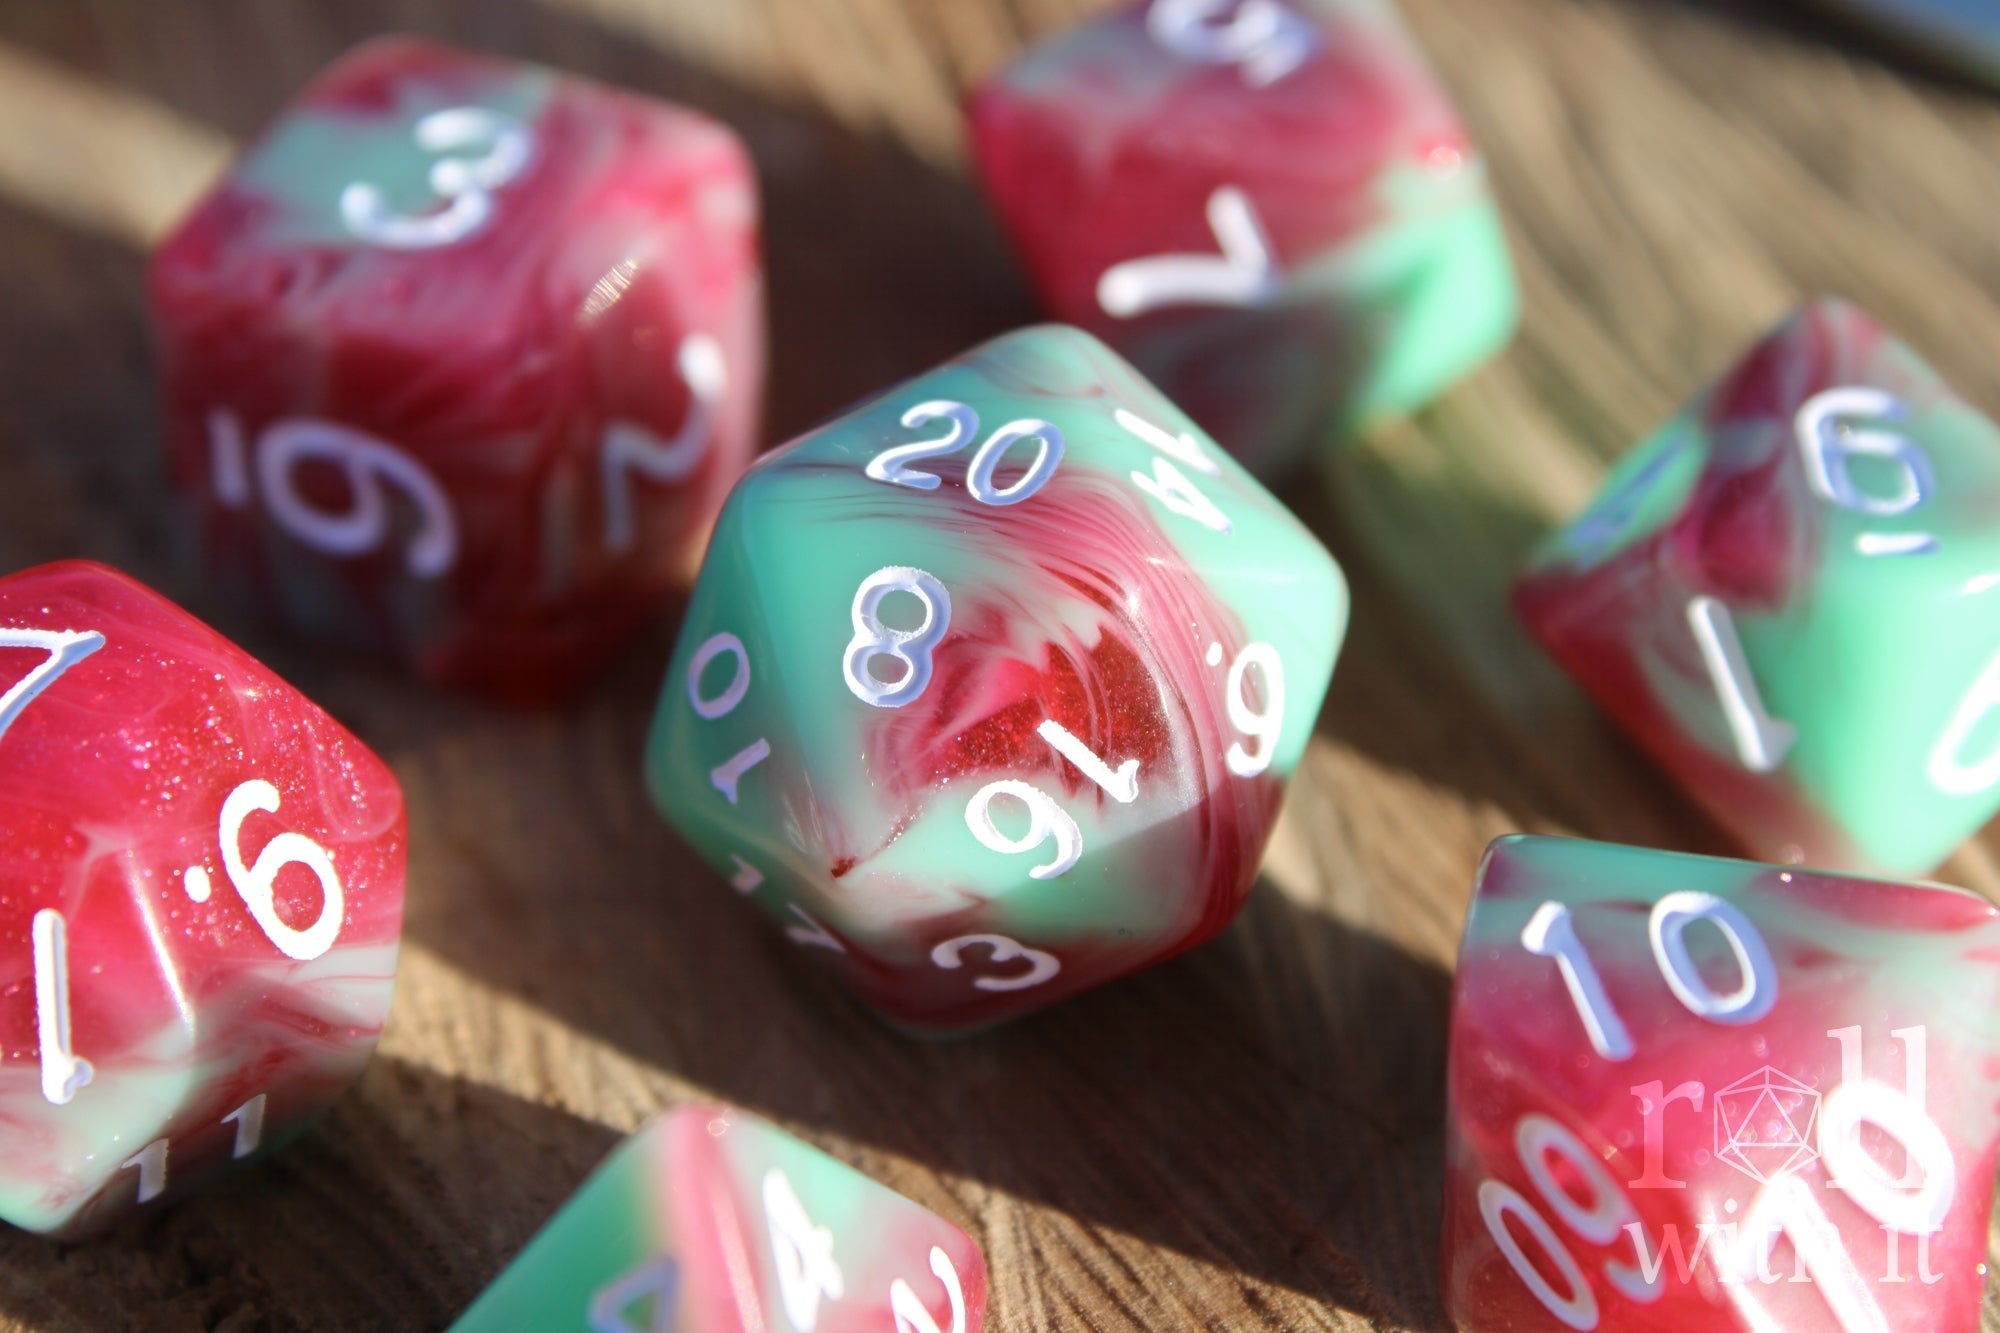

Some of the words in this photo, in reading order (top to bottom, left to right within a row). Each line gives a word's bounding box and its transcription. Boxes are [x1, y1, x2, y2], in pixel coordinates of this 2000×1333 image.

[340, 106, 534, 249] 3
[865, 400, 1065, 505] 20
[843, 566, 952, 708] 8
[965, 719, 1140, 880] 16
[931, 934, 1061, 990] 3
[1521, 889, 1779, 1061] 10
